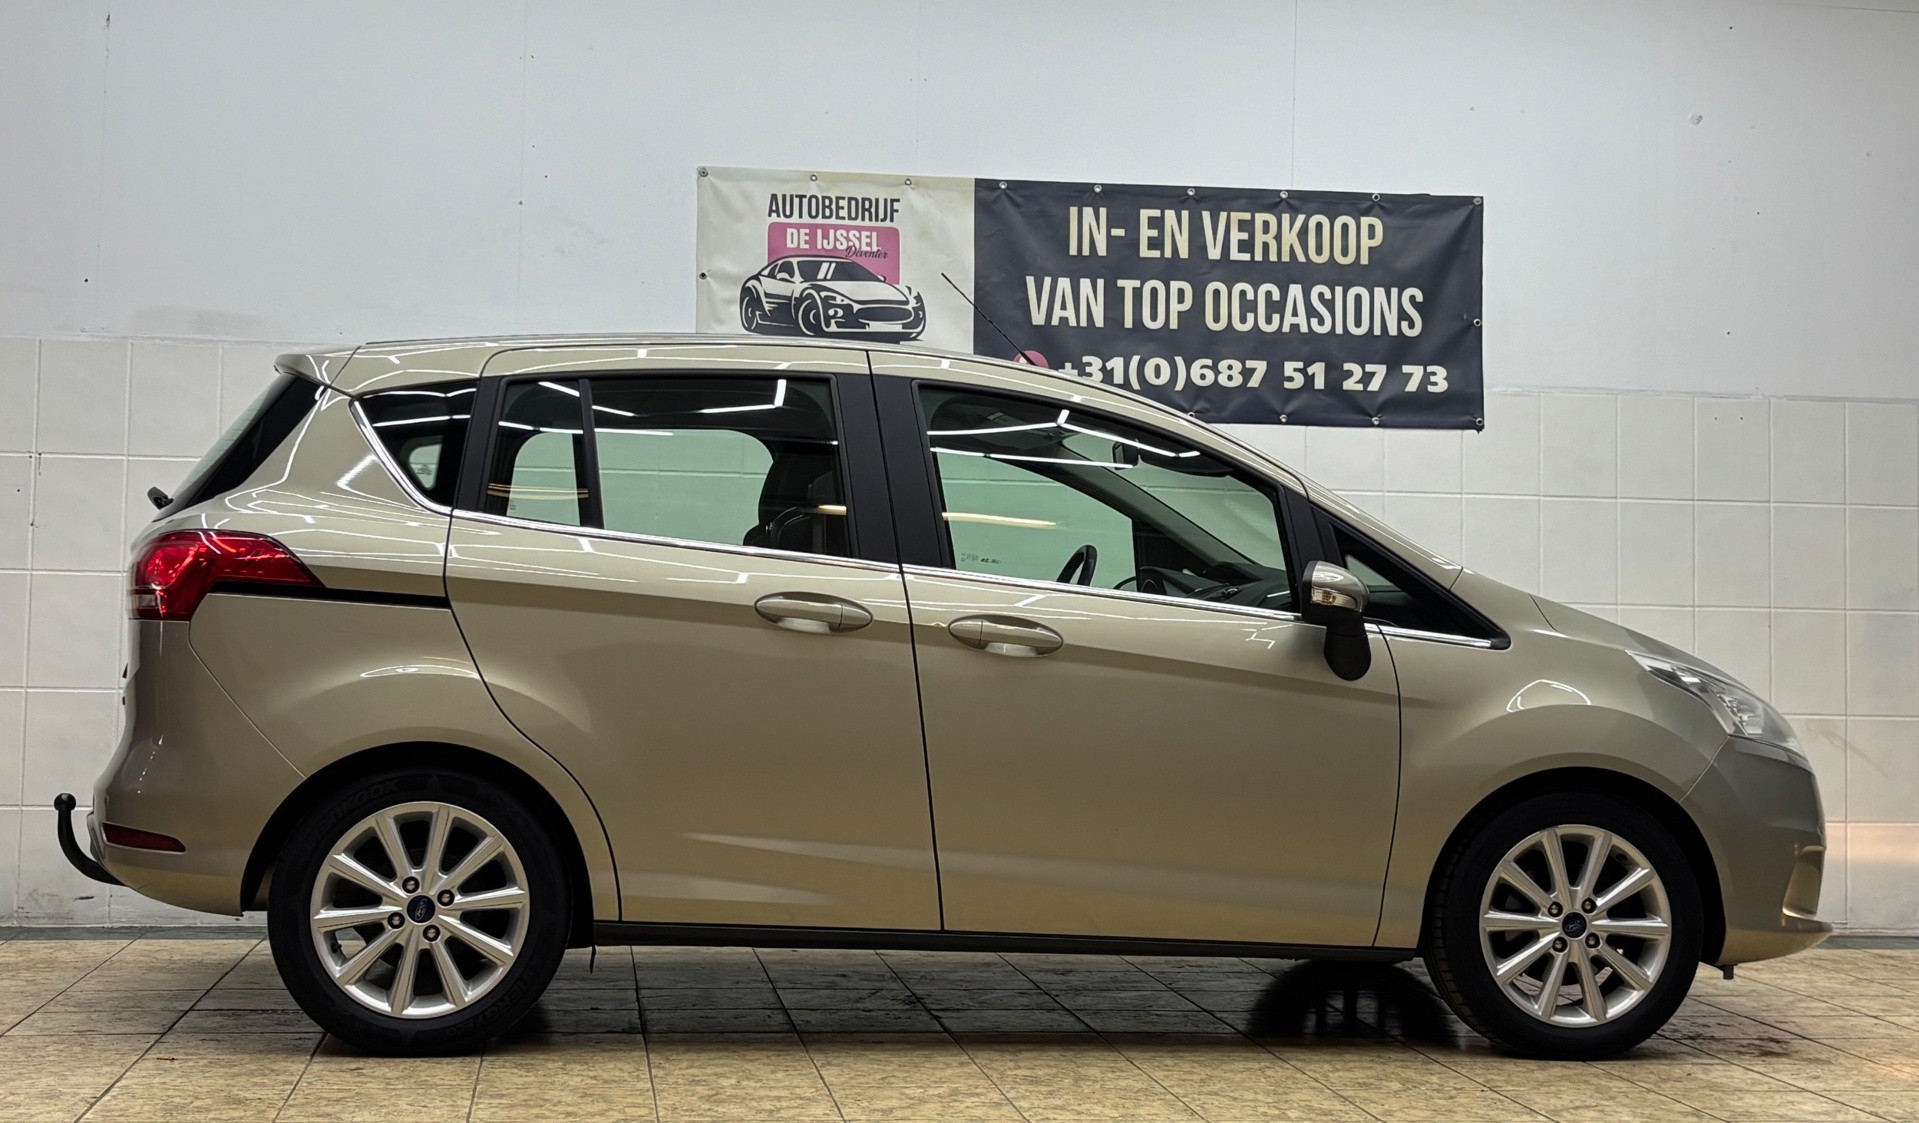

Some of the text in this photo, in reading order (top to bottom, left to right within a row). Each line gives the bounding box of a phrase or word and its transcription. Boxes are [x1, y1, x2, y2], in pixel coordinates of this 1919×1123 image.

[768, 194, 900, 223] AUTOBEDRIJF
[786, 228, 881, 251] DE IJSSEL
[845, 246, 888, 259] Deventer
[1068, 206, 1384, 266] IN- EN VERKOOP
[1025, 275, 1424, 338] VAN TOP OCCASIONS
[1058, 355, 1450, 394] +31(0)687 51 27 73
